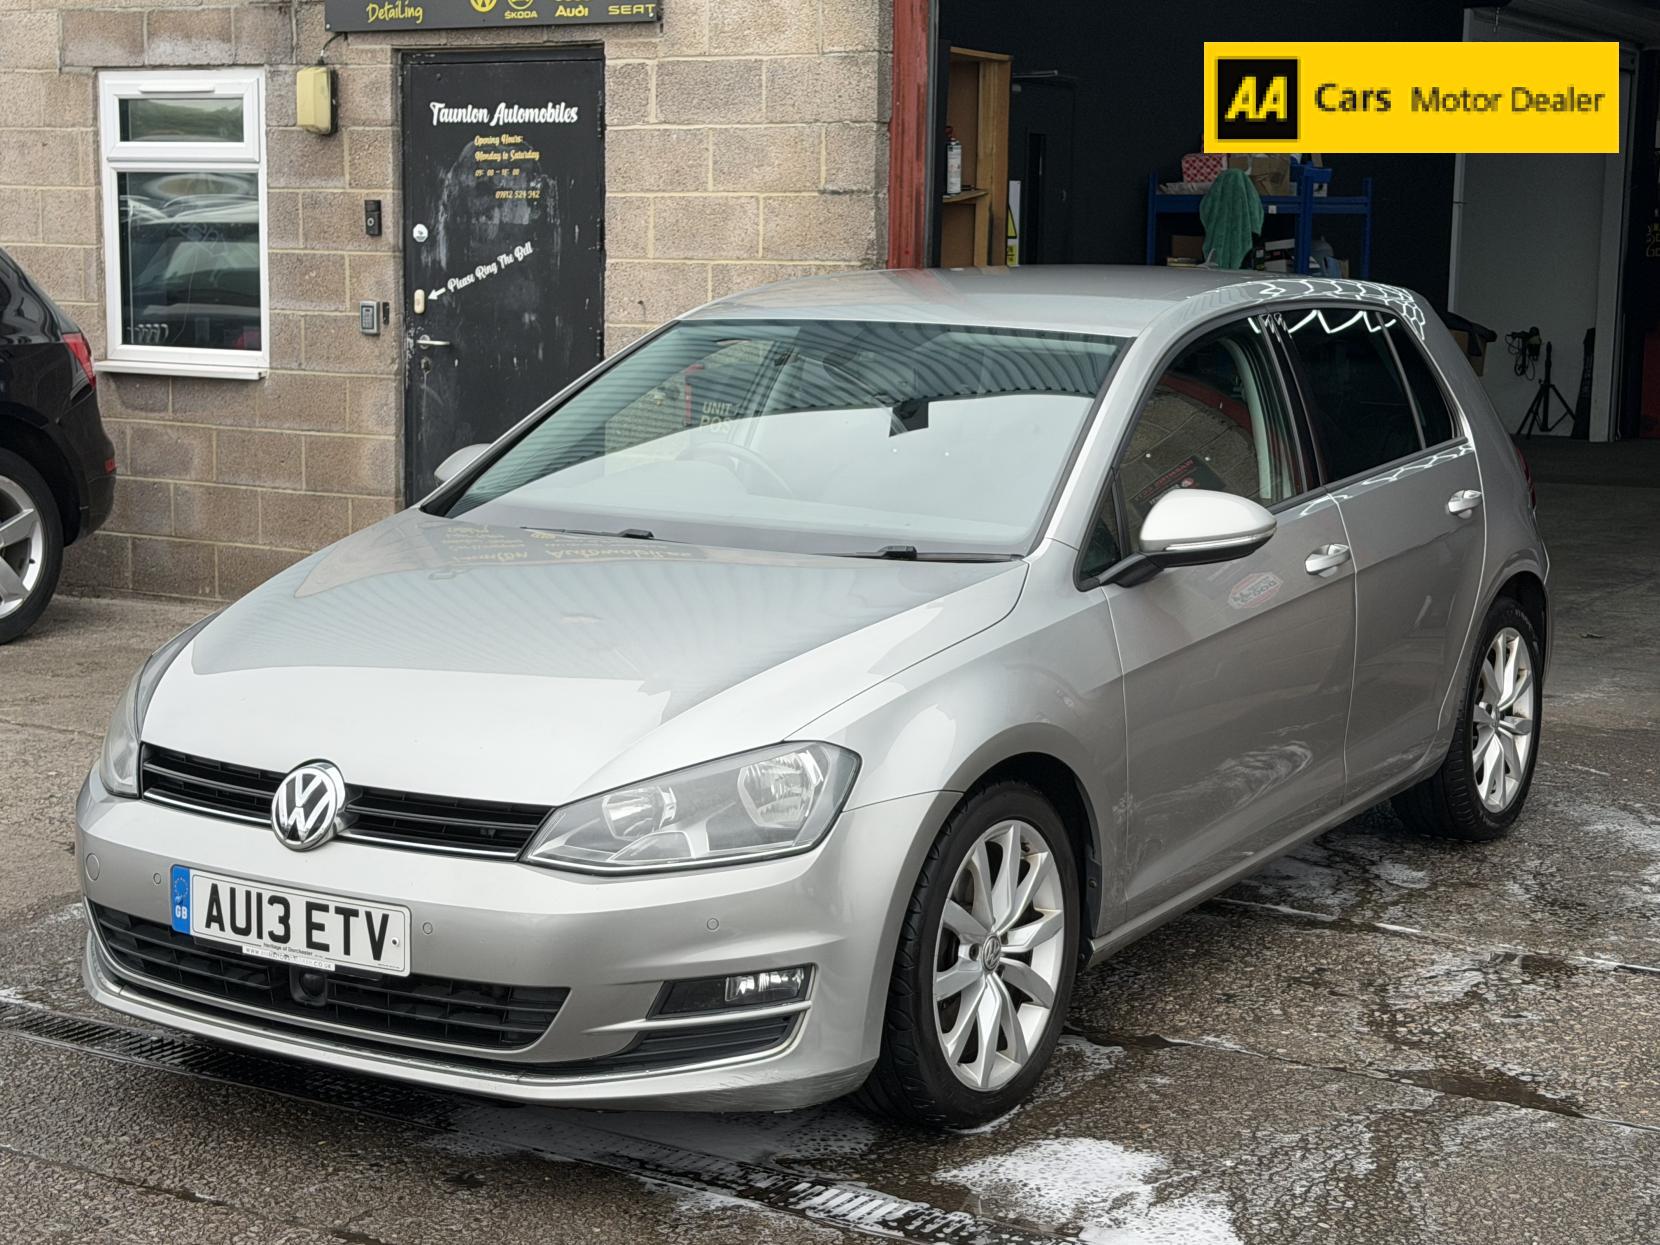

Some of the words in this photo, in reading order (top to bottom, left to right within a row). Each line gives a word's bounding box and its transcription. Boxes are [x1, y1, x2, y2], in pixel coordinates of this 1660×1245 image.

[555, 5, 588, 17] Audi
[608, 4, 656, 15] SEAT
[429, 101, 490, 126] Taunton
[489, 101, 579, 126] Automobiles
[474, 134, 500, 147] Opening
[474, 150, 501, 162] Monday
[502, 150, 509, 160] to
[510, 149, 540, 161] Saturday
[447, 273, 476, 293] Please
[475, 262, 498, 280] Ring
[497, 253, 515, 269] The
[514, 241, 534, 262] Bell
[175, 904, 188, 920] GB
[204, 883, 292, 945] AU13
[305, 900, 390, 961] ETV
